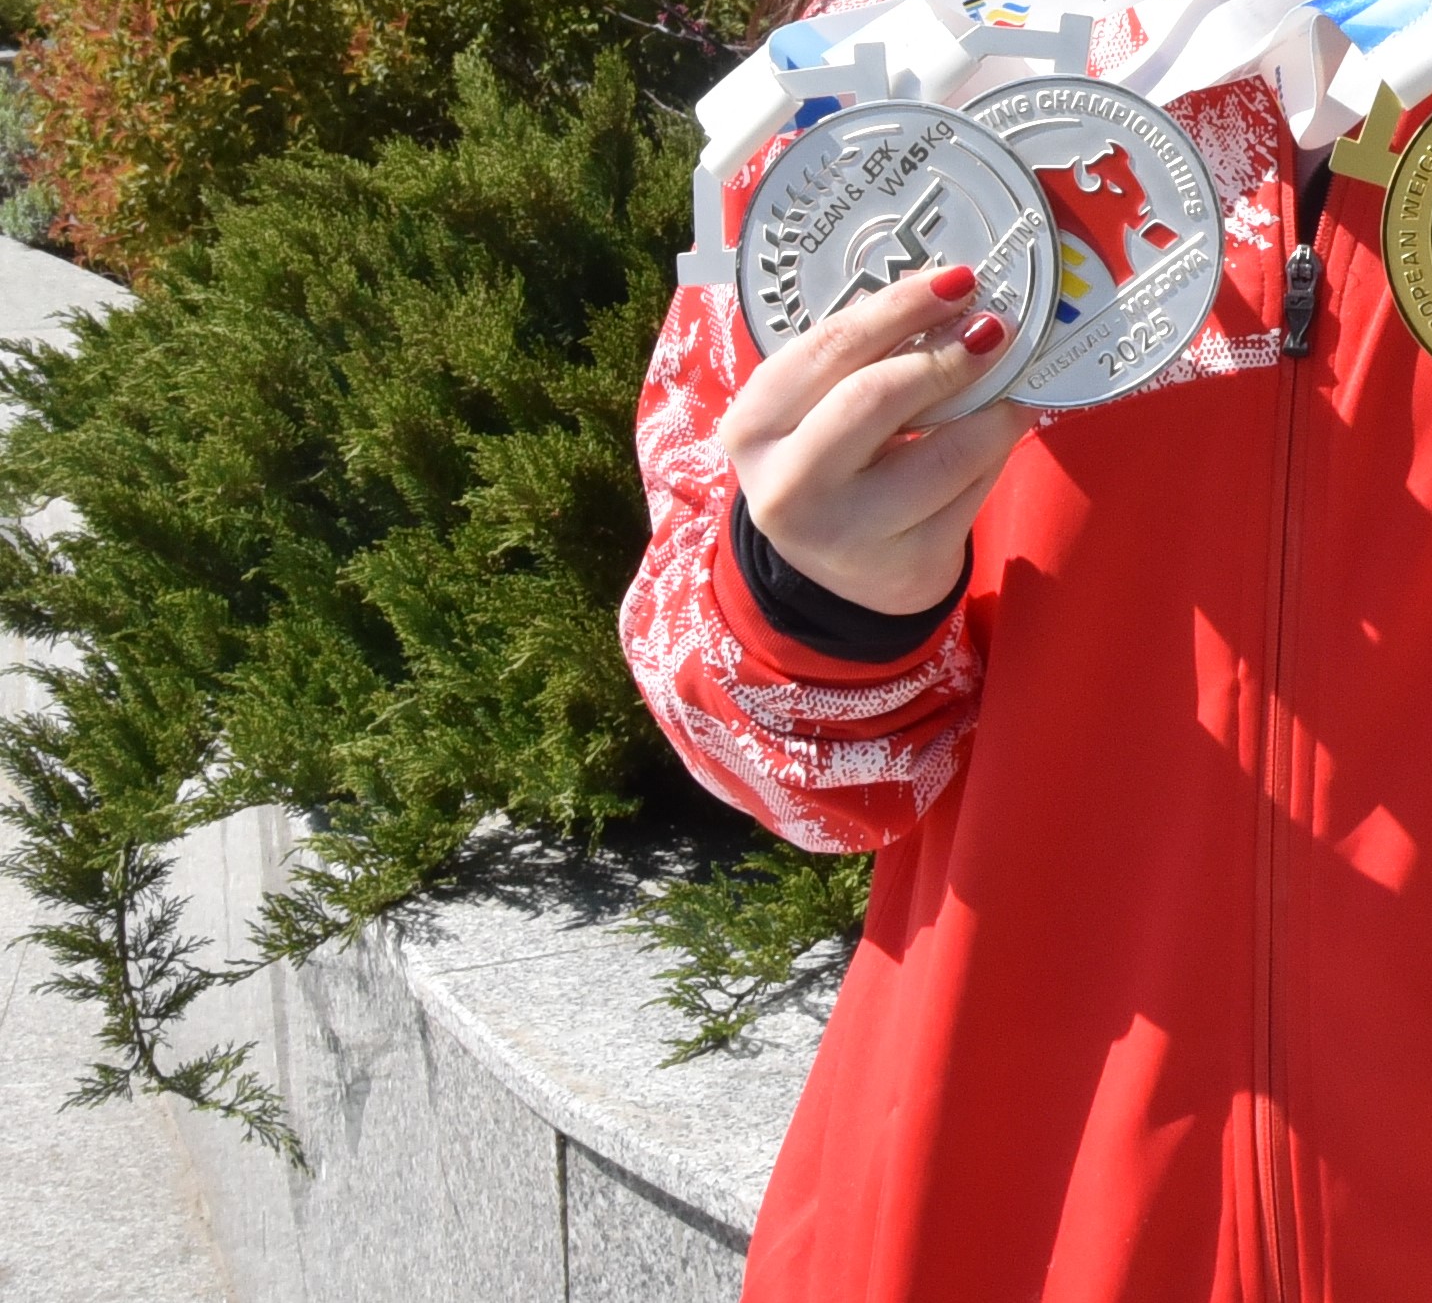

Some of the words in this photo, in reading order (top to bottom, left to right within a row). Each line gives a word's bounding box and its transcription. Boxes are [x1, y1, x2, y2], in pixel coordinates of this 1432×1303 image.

[800, 197, 851, 254] CLEAN
[845, 183, 865, 202] &
[862, 139, 900, 185] JERK
[1035, 89, 1205, 218] CHAMPIONSHIPS
[1027, 323, 1112, 391] CHISINAU
[1120, 248, 1210, 317] MOLDOVA
[1098, 307, 1176, 382] 2025
